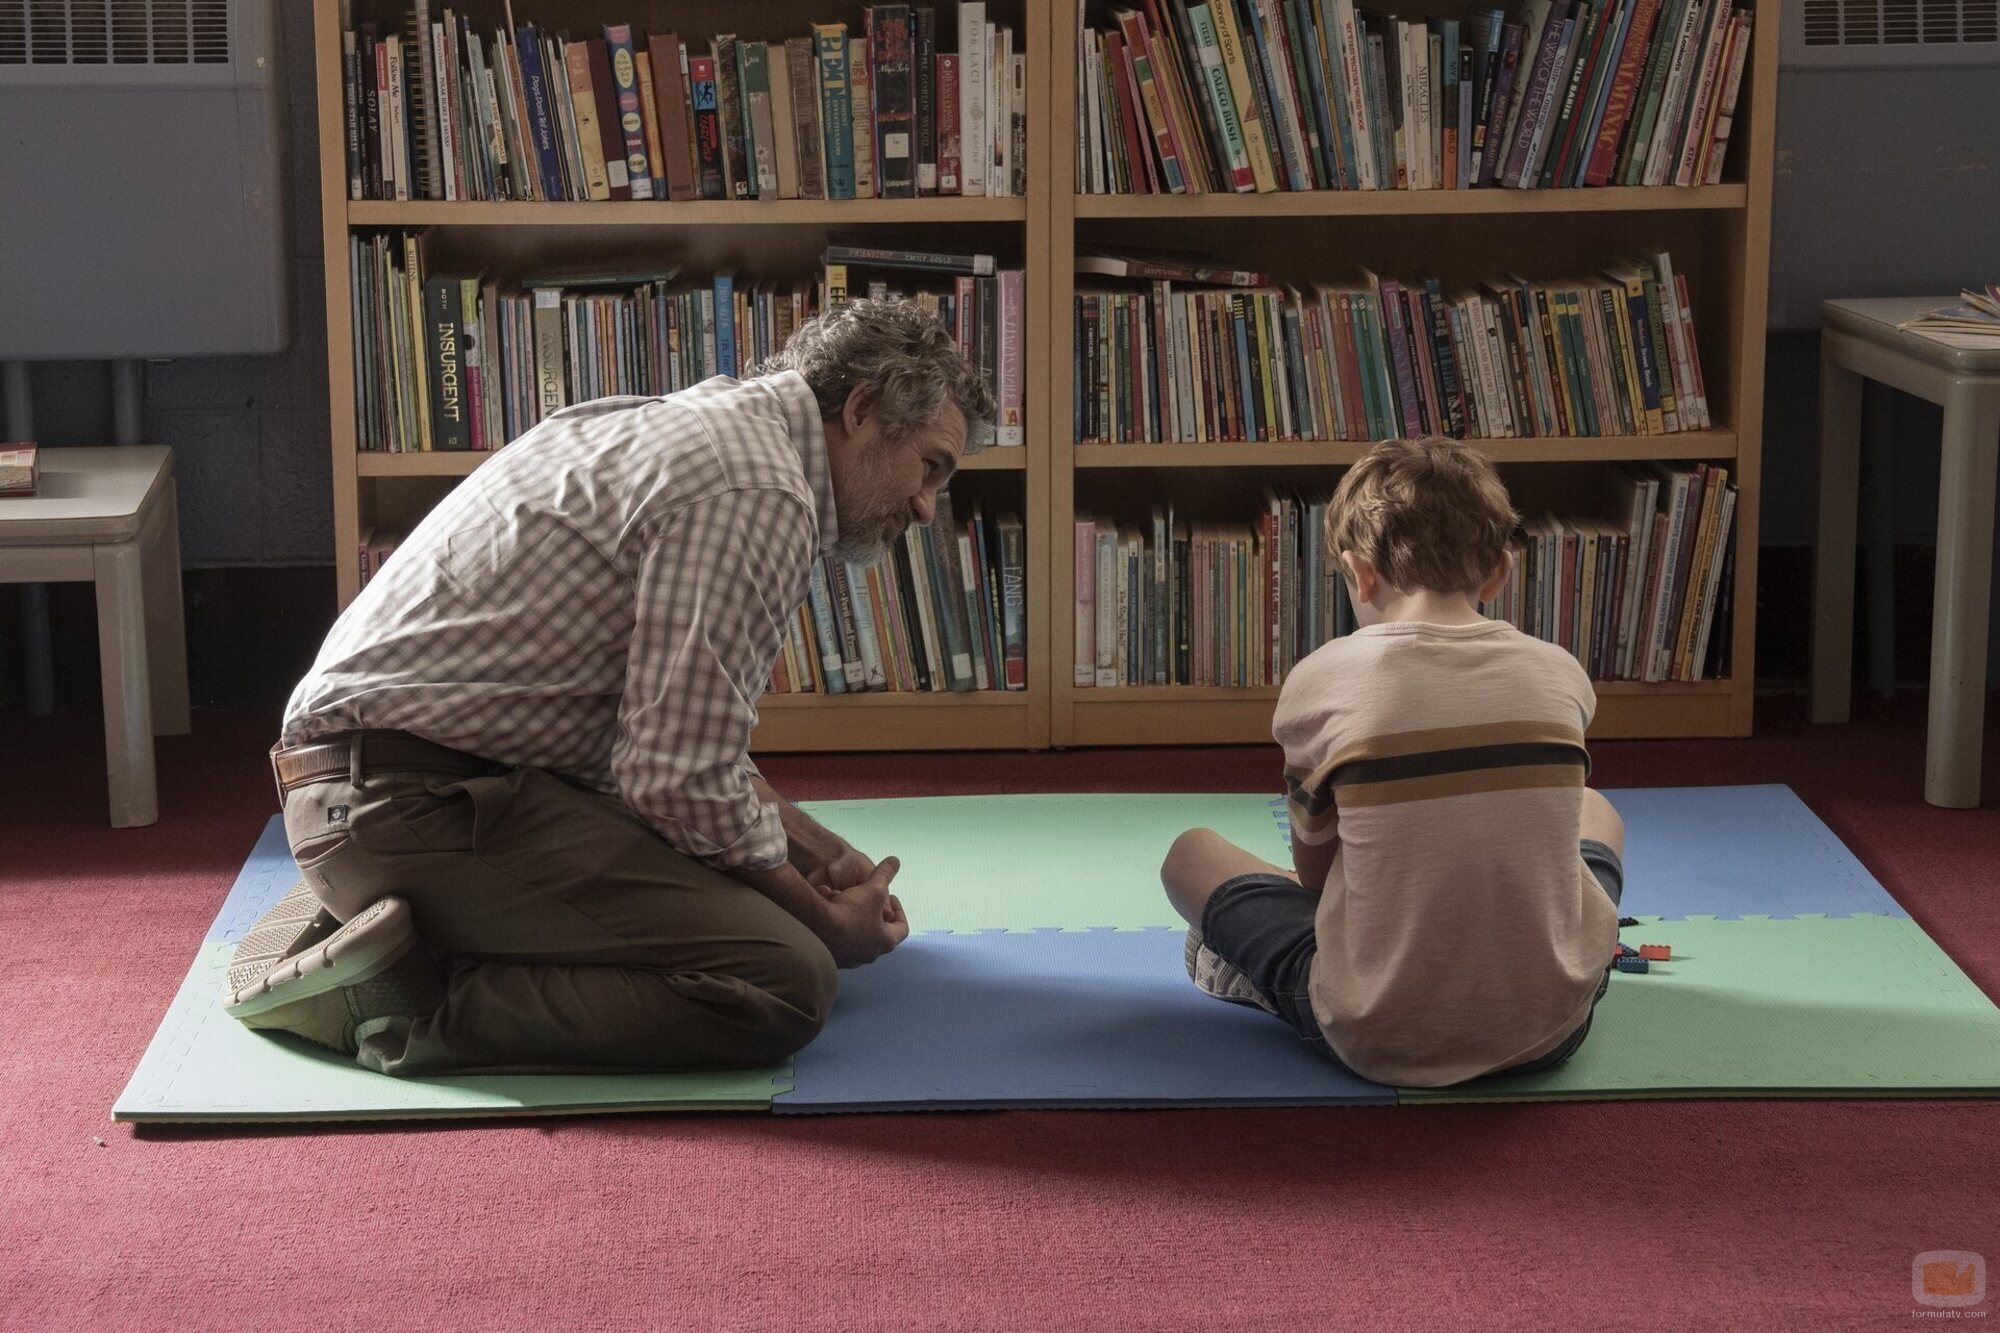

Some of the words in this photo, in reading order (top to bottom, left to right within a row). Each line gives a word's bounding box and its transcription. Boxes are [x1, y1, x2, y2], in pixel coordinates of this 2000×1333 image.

[1685, 11, 1696, 33] Little
[1717, 0, 1730, 30] STORIES
[1200, 21, 1212, 47] FIELD
[1548, 19, 1562, 41] THE
[821, 31, 845, 97] P.E.T.
[1224, 39, 1236, 65] Sports
[1543, 42, 1557, 66] WAY
[1674, 35, 1689, 72] Lookouts
[1708, 42, 1720, 68] Joshua
[390, 56, 398, 83] Follow
[1551, 54, 1564, 83] Salute
[1573, 57, 1585, 81] WILD
[391, 84, 399, 98] Me
[531, 75, 541, 96] Dogs
[1347, 34, 1355, 54] FIRST
[1353, 88, 1361, 111] WORD
[1357, 111, 1365, 131] BOOK
[1418, 66, 1428, 124] MIRACLES
[1700, 80, 1711, 105] Queen
[1212, 68, 1228, 107] CALICO
[1222, 109, 1237, 142] BUSH
[1531, 86, 1546, 107] THE
[1562, 84, 1577, 120] BABIES
[1599, 59, 1635, 150] ALMANAC
[367, 89, 377, 133] SOLAY
[538, 116, 547, 128] Tell
[1537, 93, 1553, 131] Courage
[1694, 107, 1705, 131] Esther
[350, 129, 358, 152] BILLY
[541, 128, 550, 150] Jokes
[921, 116, 929, 146] WOOD
[1518, 108, 1537, 148] WORLD
[1487, 138, 1499, 168] BEAUTY
[905, 254, 926, 262] EMILY
[930, 255, 952, 264] GOULD
[1479, 344, 1488, 362] AND
[1641, 347, 1650, 369] Scout
[438, 322, 459, 422] INSURGENT
[542, 332, 560, 417] INSURGEN
[1644, 369, 1653, 388] Book
[1676, 486, 1686, 510] SUPER
[1672, 510, 1683, 537] SPORTS
[1666, 538, 1679, 575] QUESTION
[1663, 575, 1673, 591] AND
[1119, 590, 1127, 606] The
[1659, 592, 1670, 622] ANSWER
[1118, 607, 1127, 628] Magic
[1119, 629, 1127, 647] Half
[1657, 623, 1665, 645] BOOK
